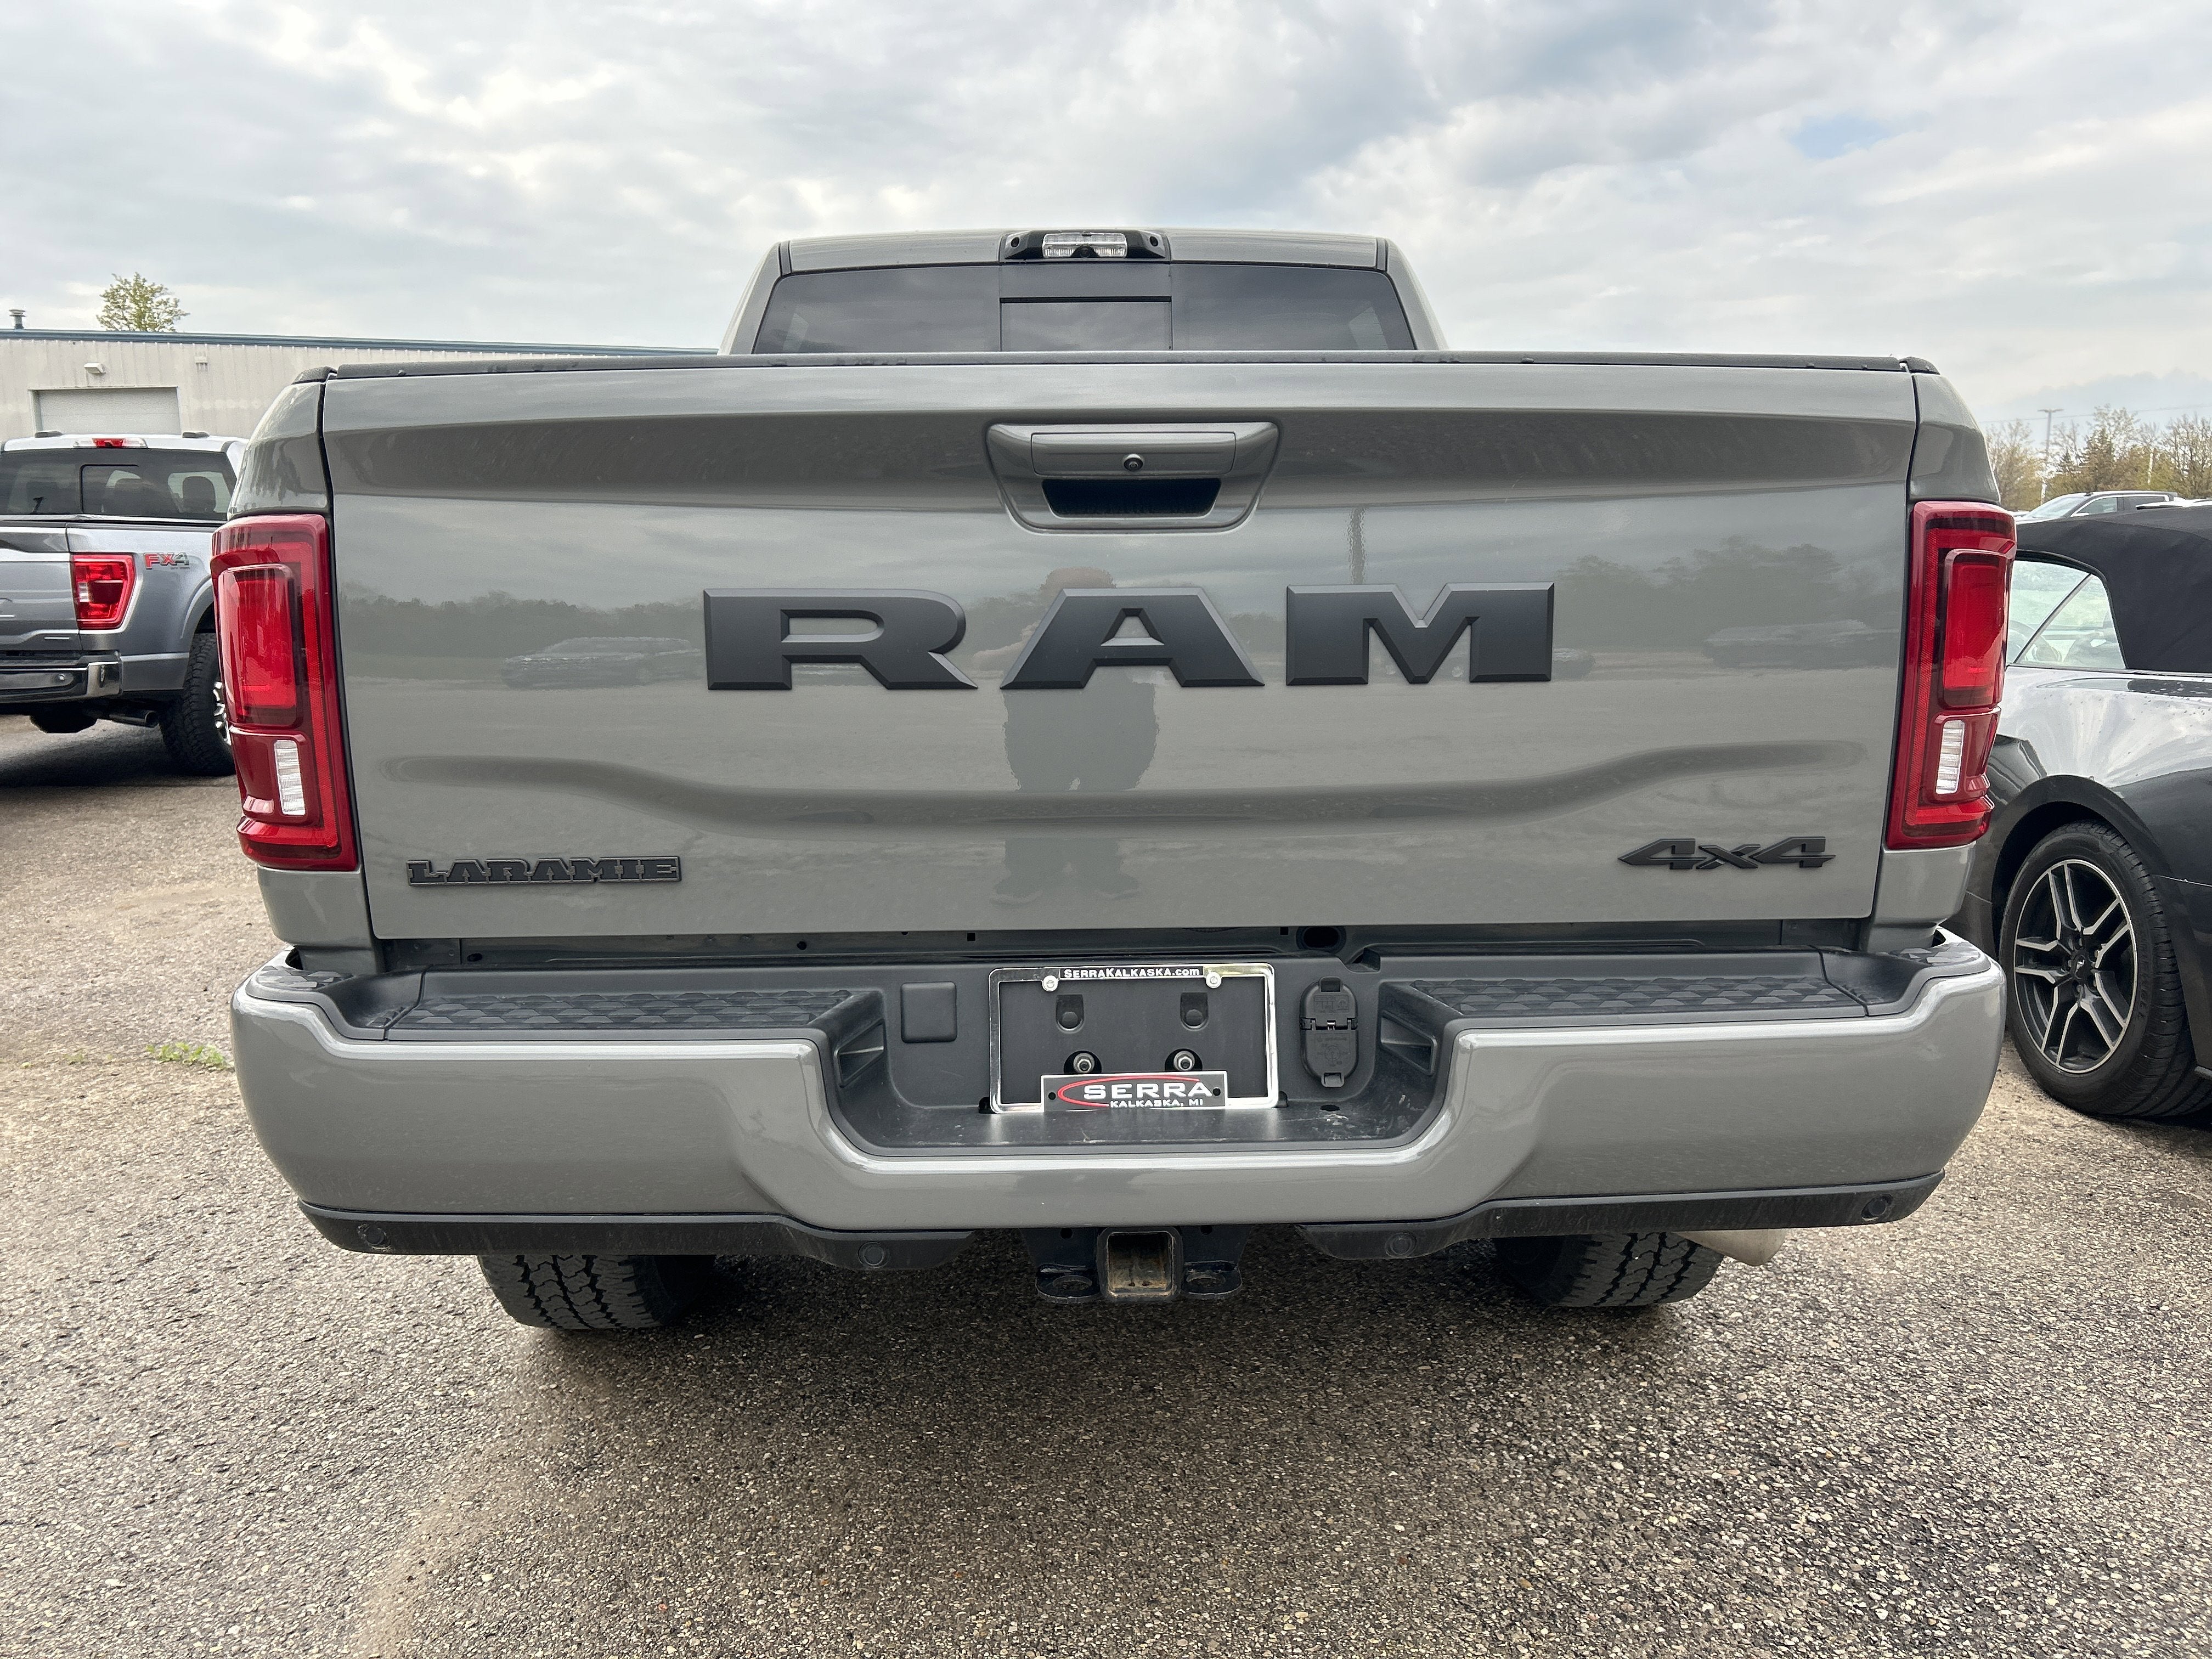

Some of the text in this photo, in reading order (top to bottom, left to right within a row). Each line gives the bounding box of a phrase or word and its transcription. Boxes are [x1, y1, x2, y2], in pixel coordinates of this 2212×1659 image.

[144, 552, 189, 569] FX4
[703, 583, 1554, 690] RAM
[406, 856, 682, 887] LARAMIE
[1084, 1082, 1212, 1099] SERRA
[1110, 1099, 1183, 1108] KALKASKA,
